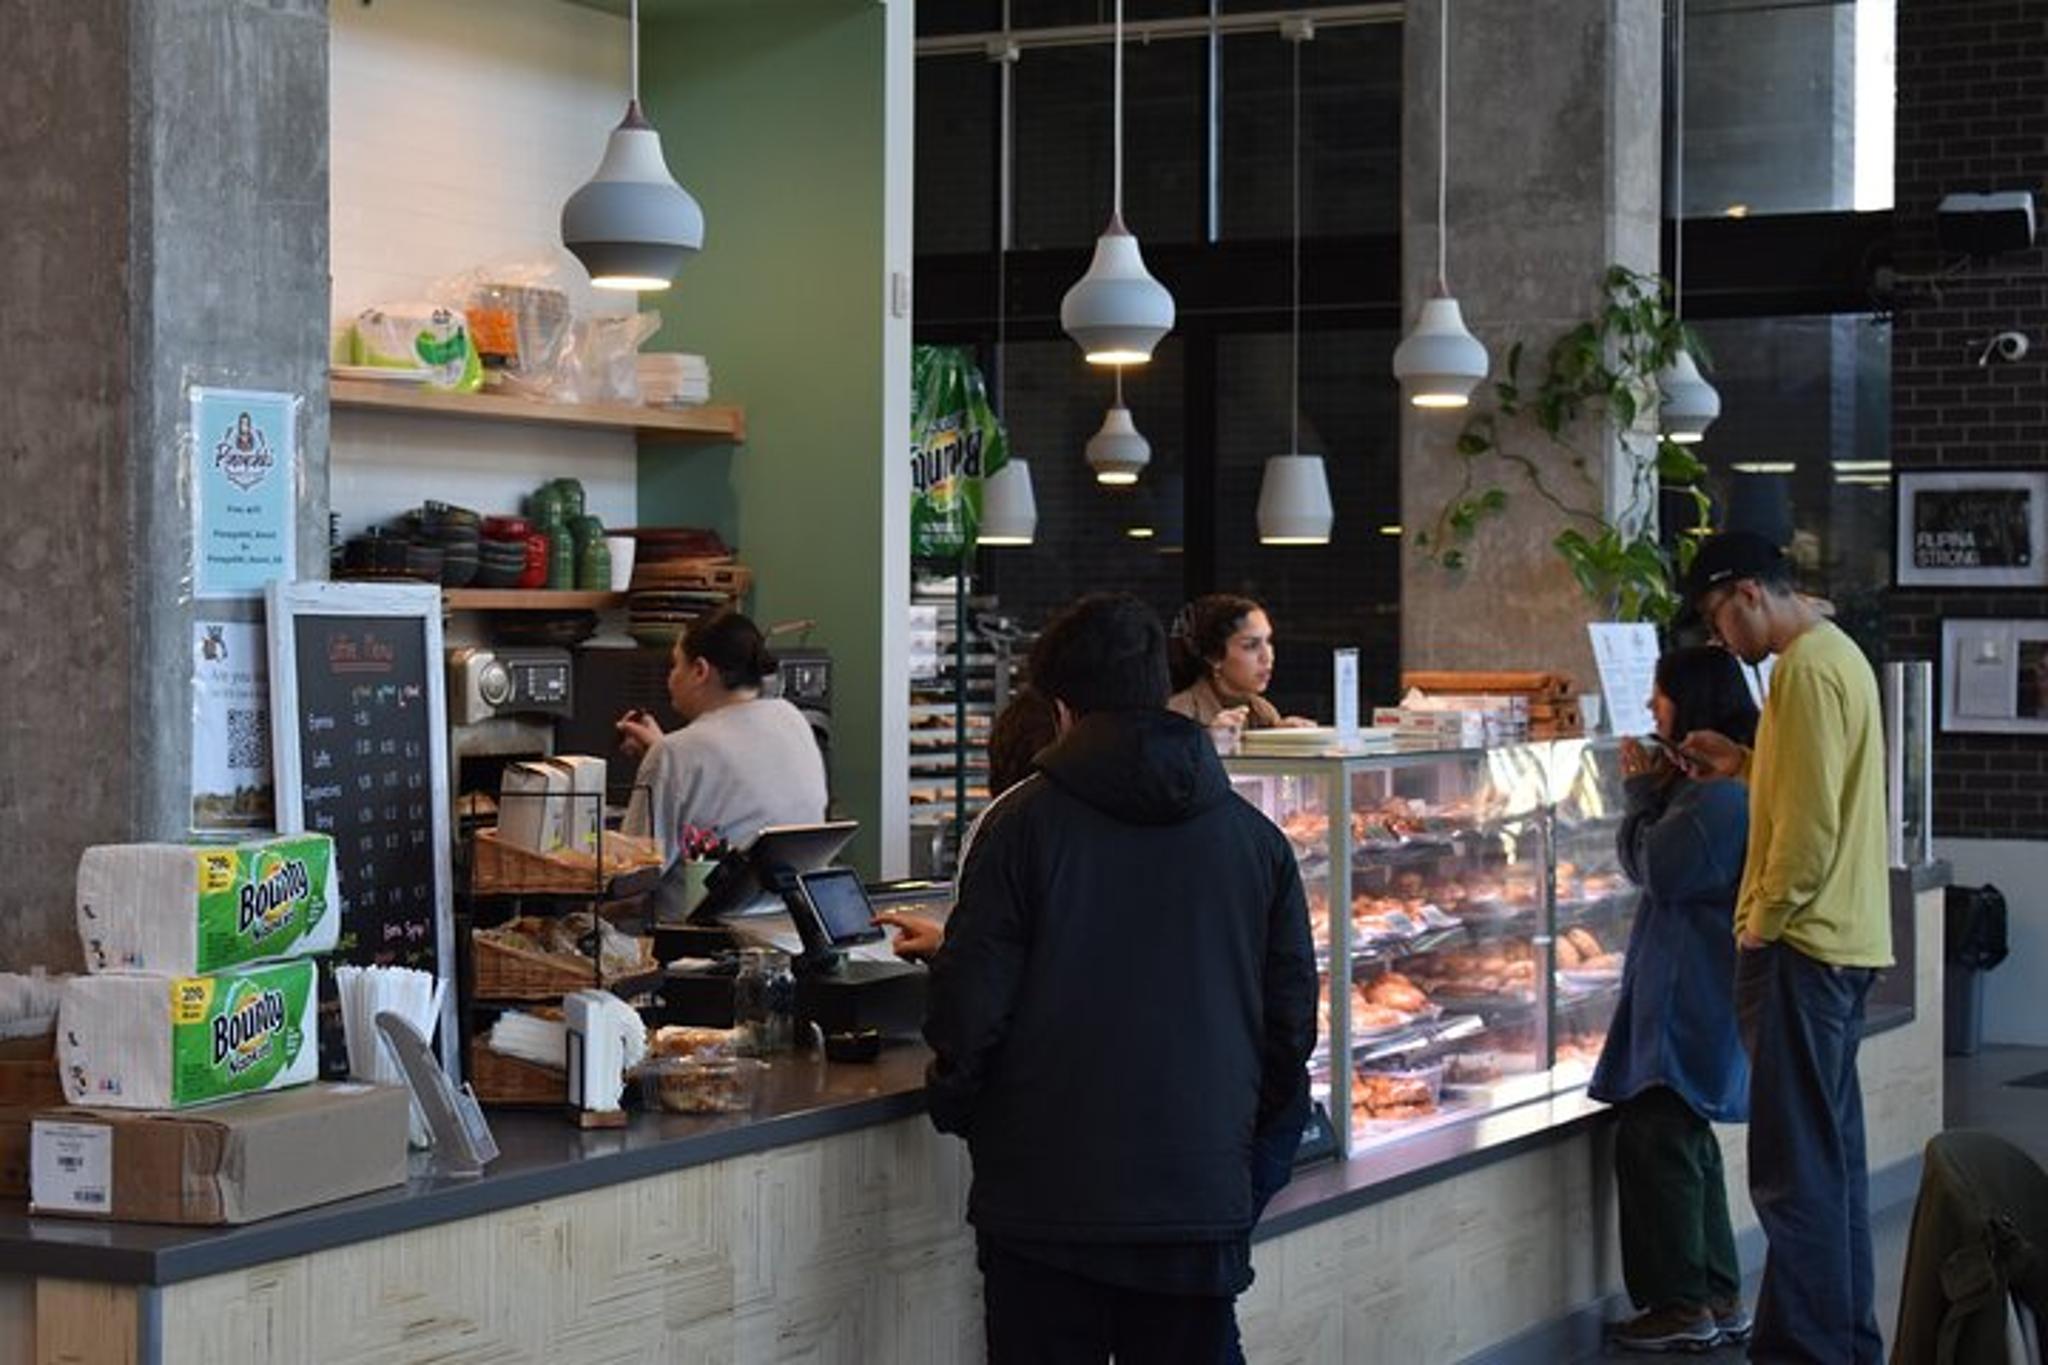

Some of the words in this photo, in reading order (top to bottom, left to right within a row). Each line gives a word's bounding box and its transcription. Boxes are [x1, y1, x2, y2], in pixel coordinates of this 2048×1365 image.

[1917, 530, 1976, 548] FILIPINA
[1917, 549, 1980, 566] STRONG
[238, 860, 308, 934] Bounty
[212, 990, 285, 1065] Bounty
